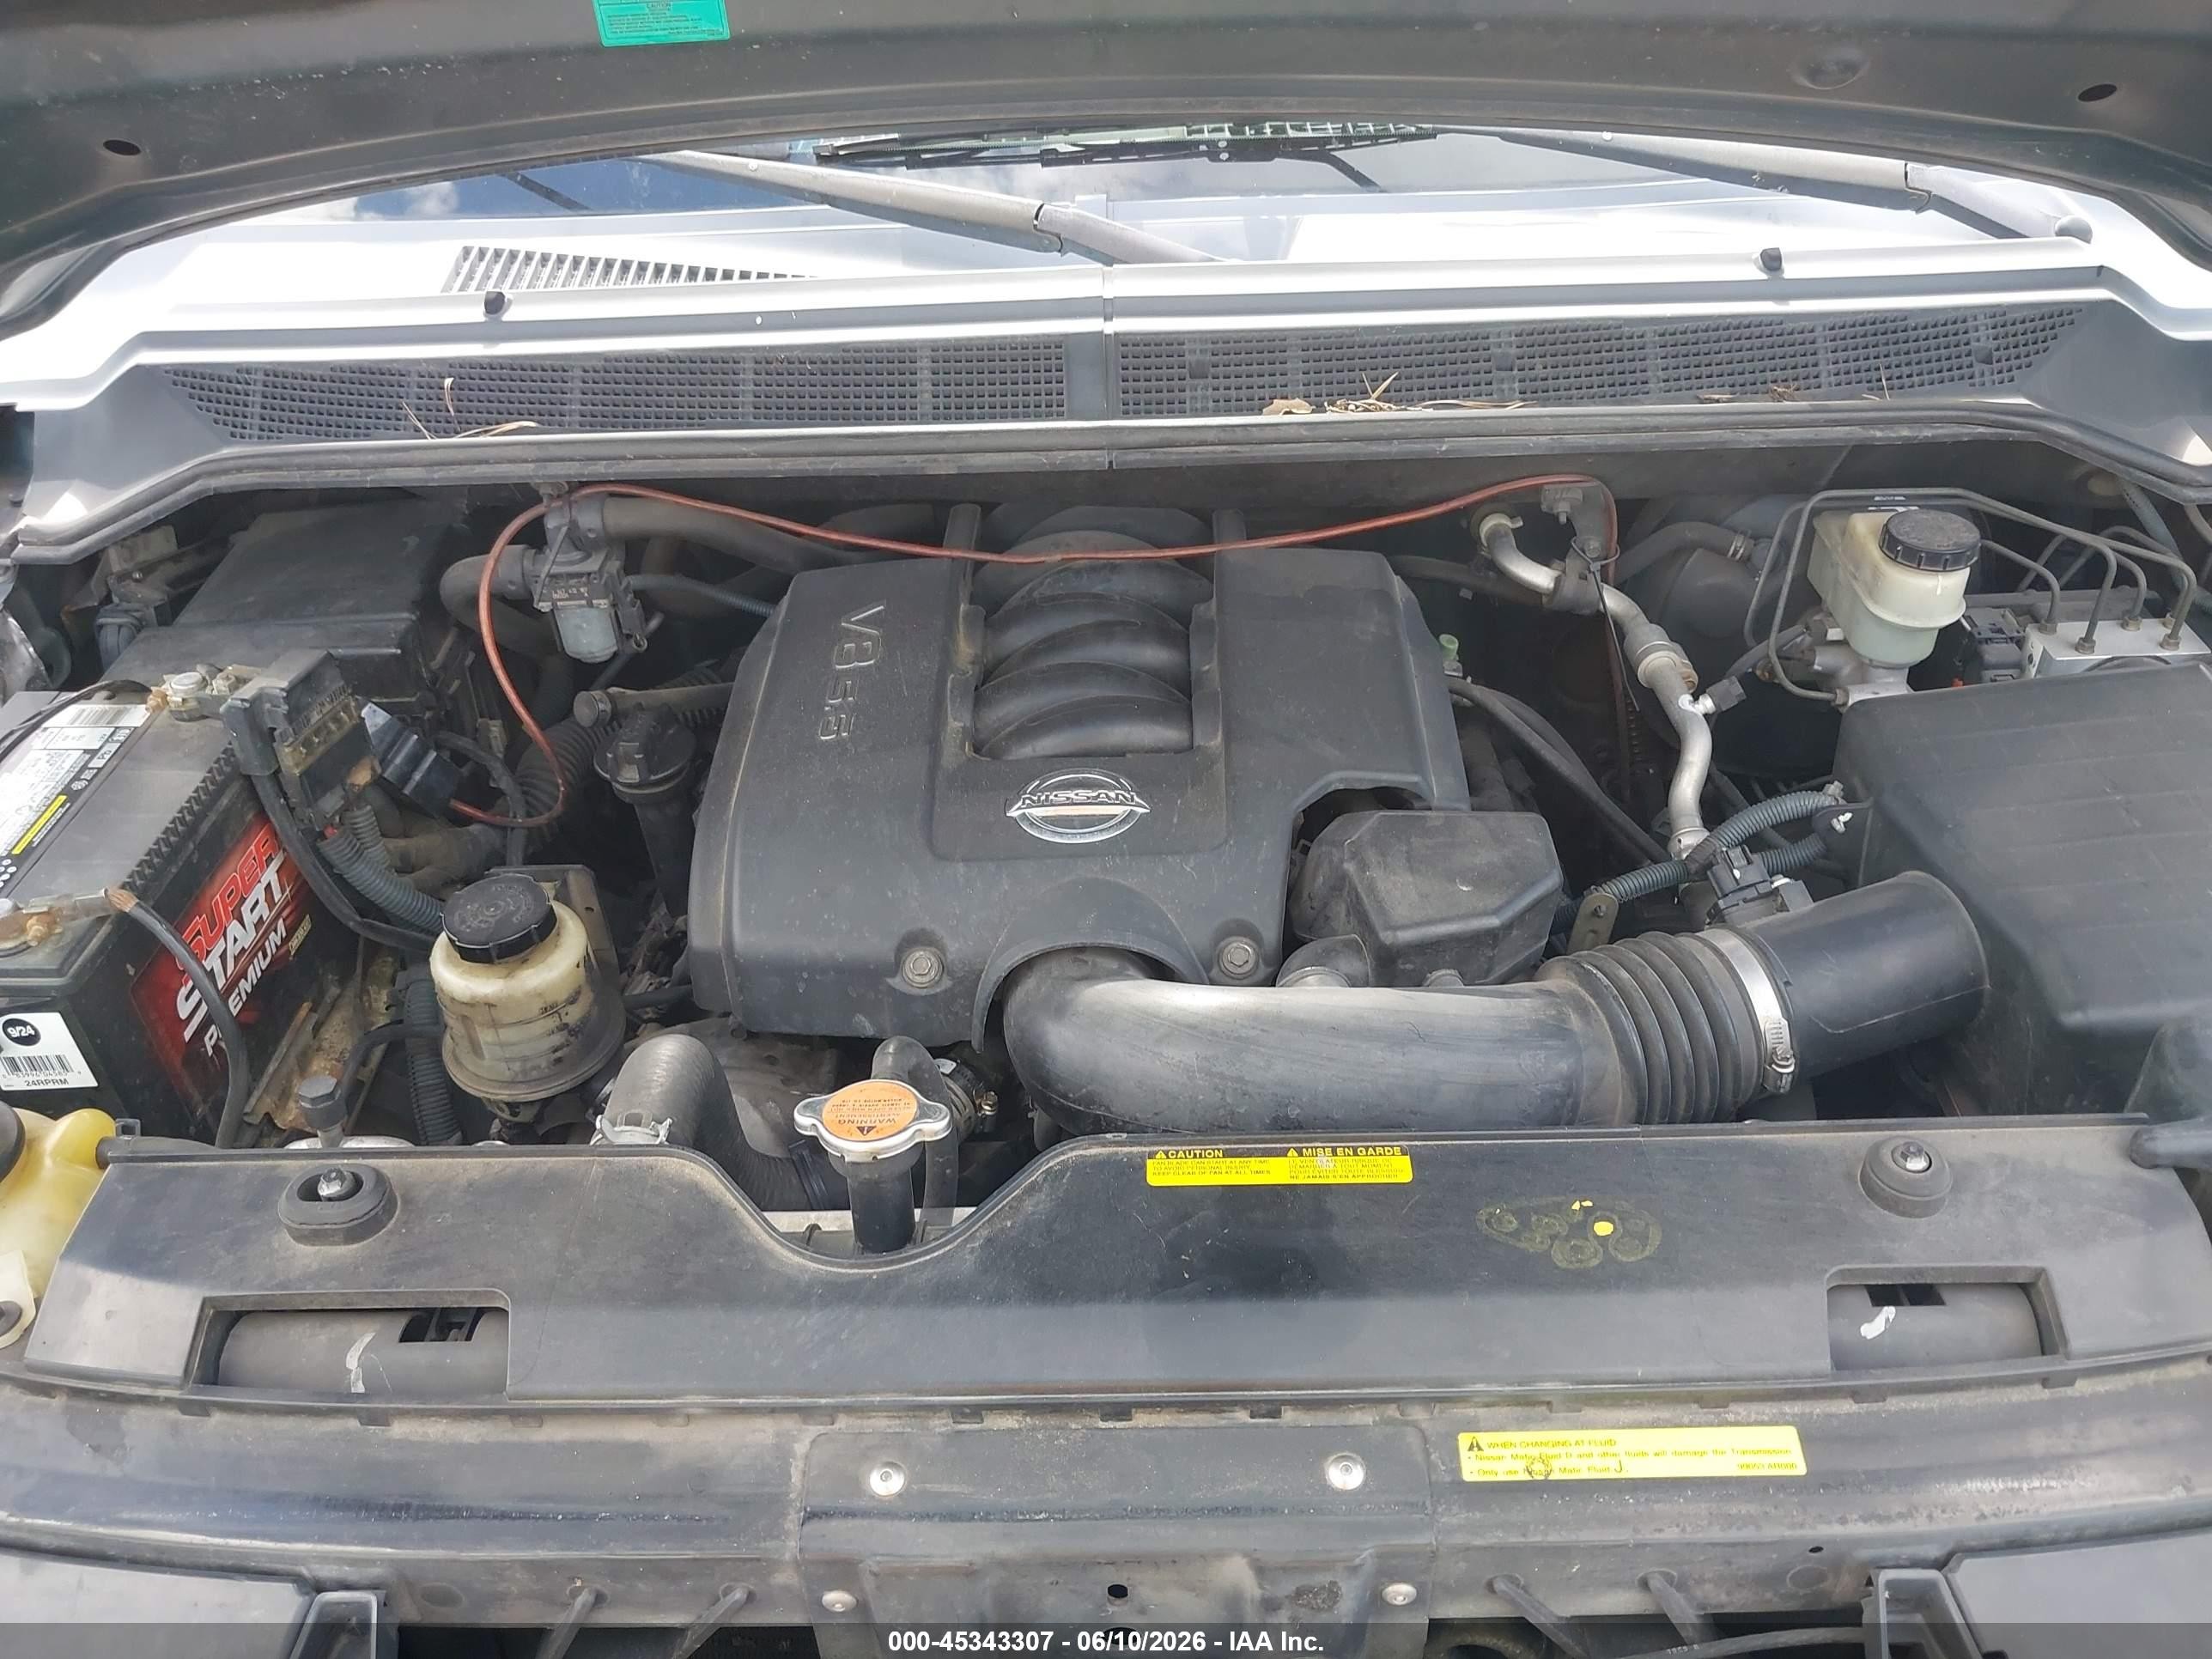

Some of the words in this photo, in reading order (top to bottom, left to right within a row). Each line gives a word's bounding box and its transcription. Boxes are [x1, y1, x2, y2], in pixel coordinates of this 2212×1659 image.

[833, 603, 884, 669] V8
[1019, 790, 1137, 807] NISSAN
[175, 823, 280, 971] SUPER
[176, 847, 286, 1043] START
[204, 916, 287, 1058] PEMIUM
[7, 1025, 35, 1038] 9/24
[24, 1079, 70, 1087] 24RPRM
[1168, 1149, 1224, 1158] CAUTION
[1302, 1147, 1333, 1157] MISE
[1336, 1147, 1353, 1156] EN
[1357, 1146, 1401, 1156] GARDE
[1519, 1440, 1571, 1449] CHANGING
[1589, 1438, 1617, 1447] FLUID
[1477, 1468, 1498, 1477] Only
